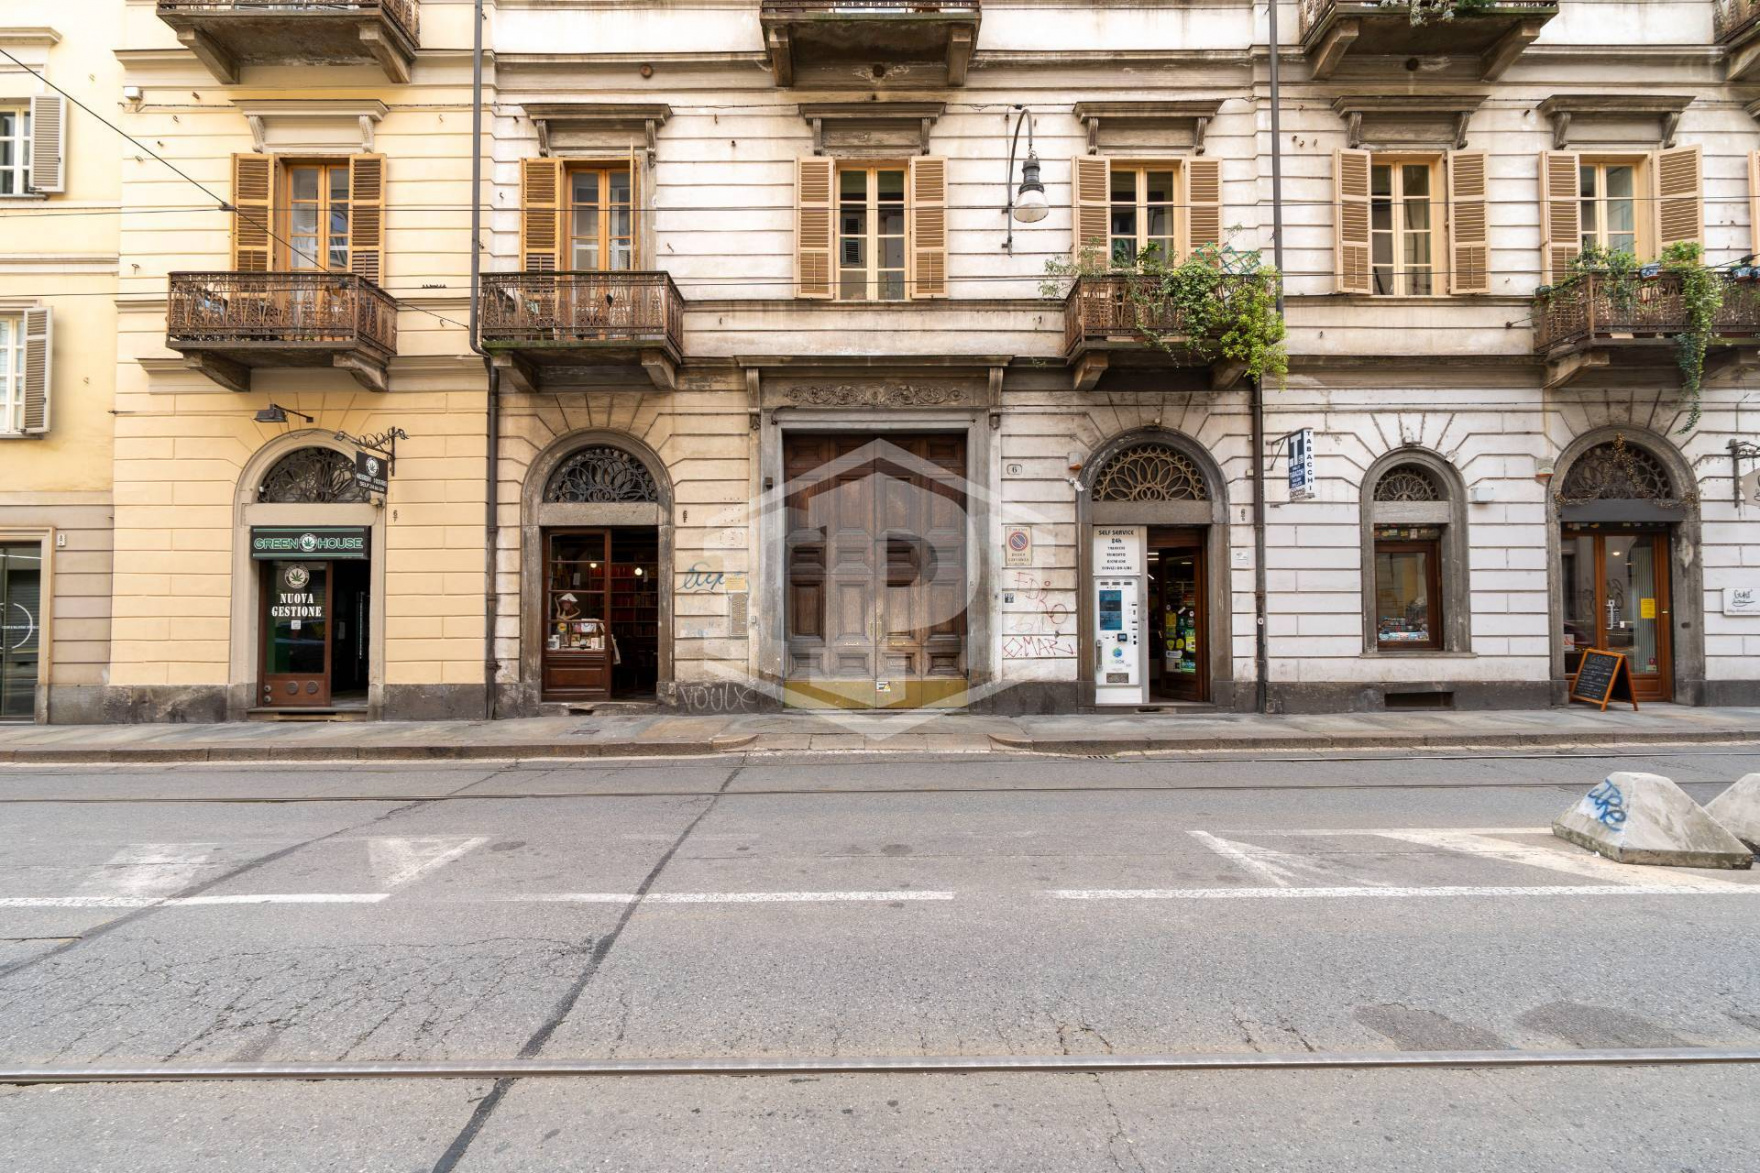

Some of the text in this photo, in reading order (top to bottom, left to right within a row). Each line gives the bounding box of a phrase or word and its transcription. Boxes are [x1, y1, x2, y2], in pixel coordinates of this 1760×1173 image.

[254, 538, 363, 549] GREEN HOUSE
[280, 593, 314, 604] NUOVA
[271, 606, 322, 617] GESTIONE
